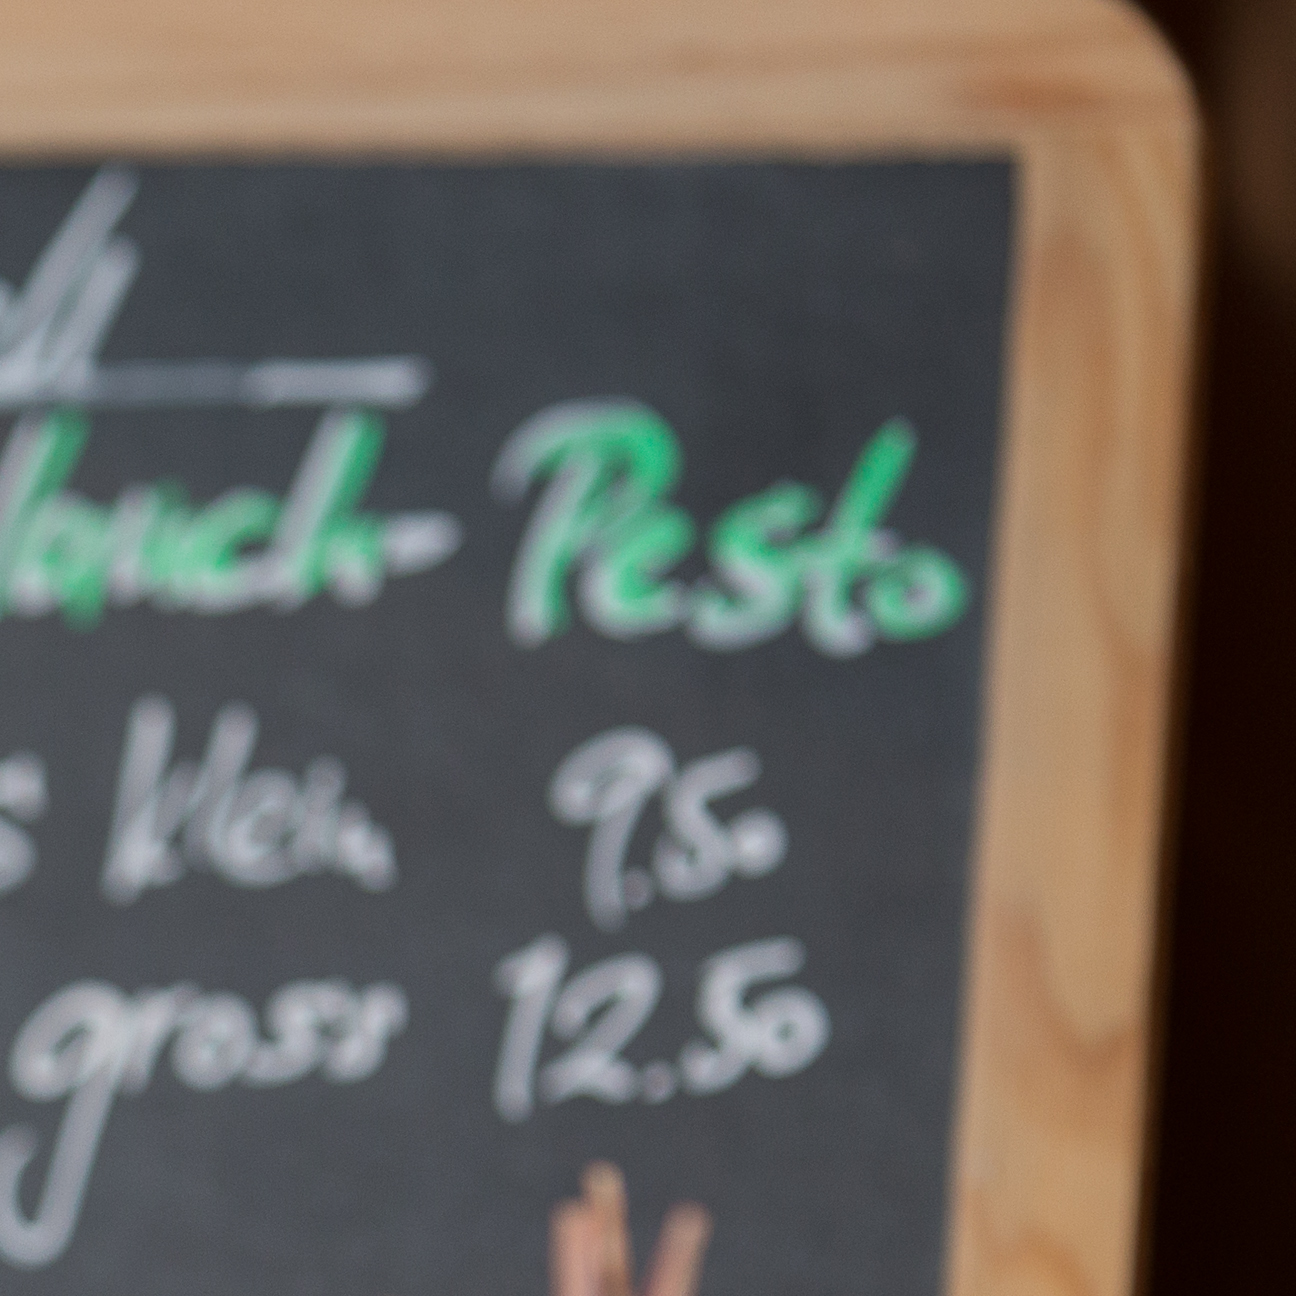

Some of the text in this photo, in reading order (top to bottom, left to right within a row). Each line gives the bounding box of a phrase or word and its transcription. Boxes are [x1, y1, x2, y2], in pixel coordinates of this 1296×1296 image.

[495, 398, 971, 656] Pesto
[101, 697, 401, 904] klein
[491, 934, 833, 1120] 12.50
